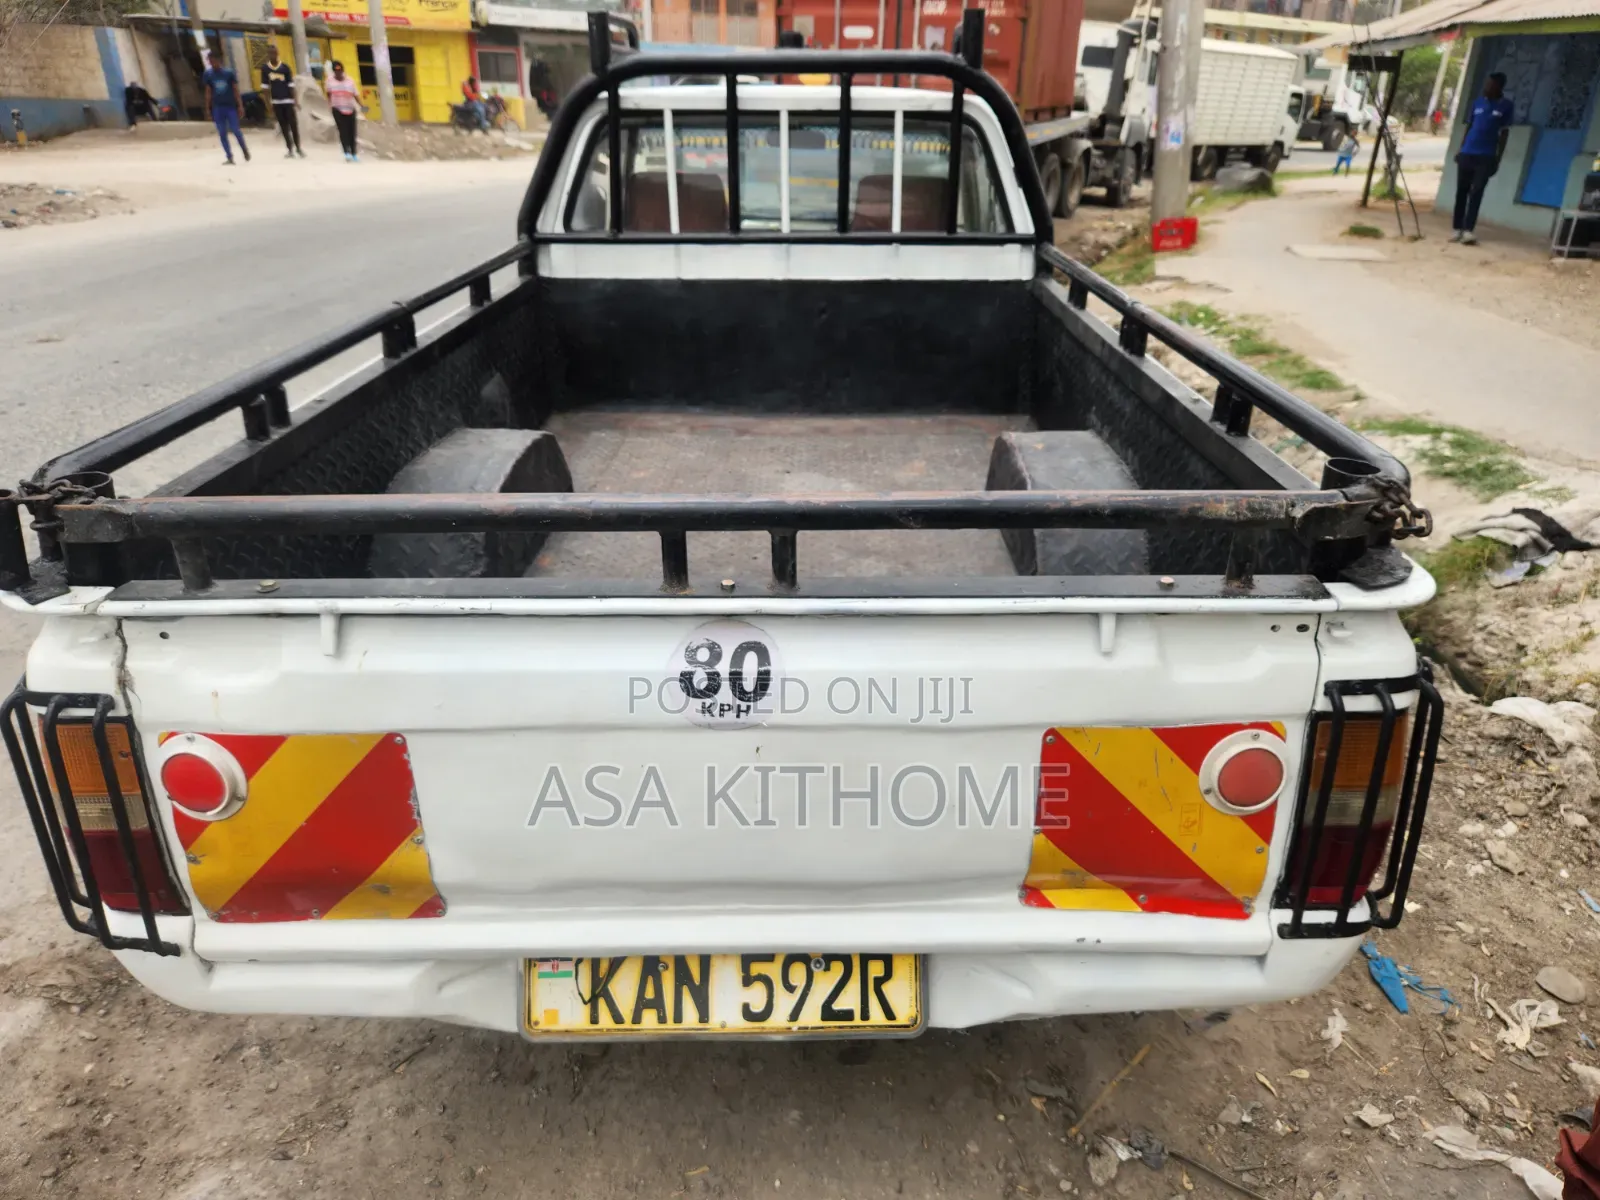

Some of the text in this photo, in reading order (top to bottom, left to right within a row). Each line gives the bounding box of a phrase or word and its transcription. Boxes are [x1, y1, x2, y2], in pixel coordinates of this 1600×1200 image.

[678, 637, 773, 702] 80
[699, 702, 754, 720] KPH
[590, 954, 710, 1024] KAN
[741, 954, 898, 1022] 592R
